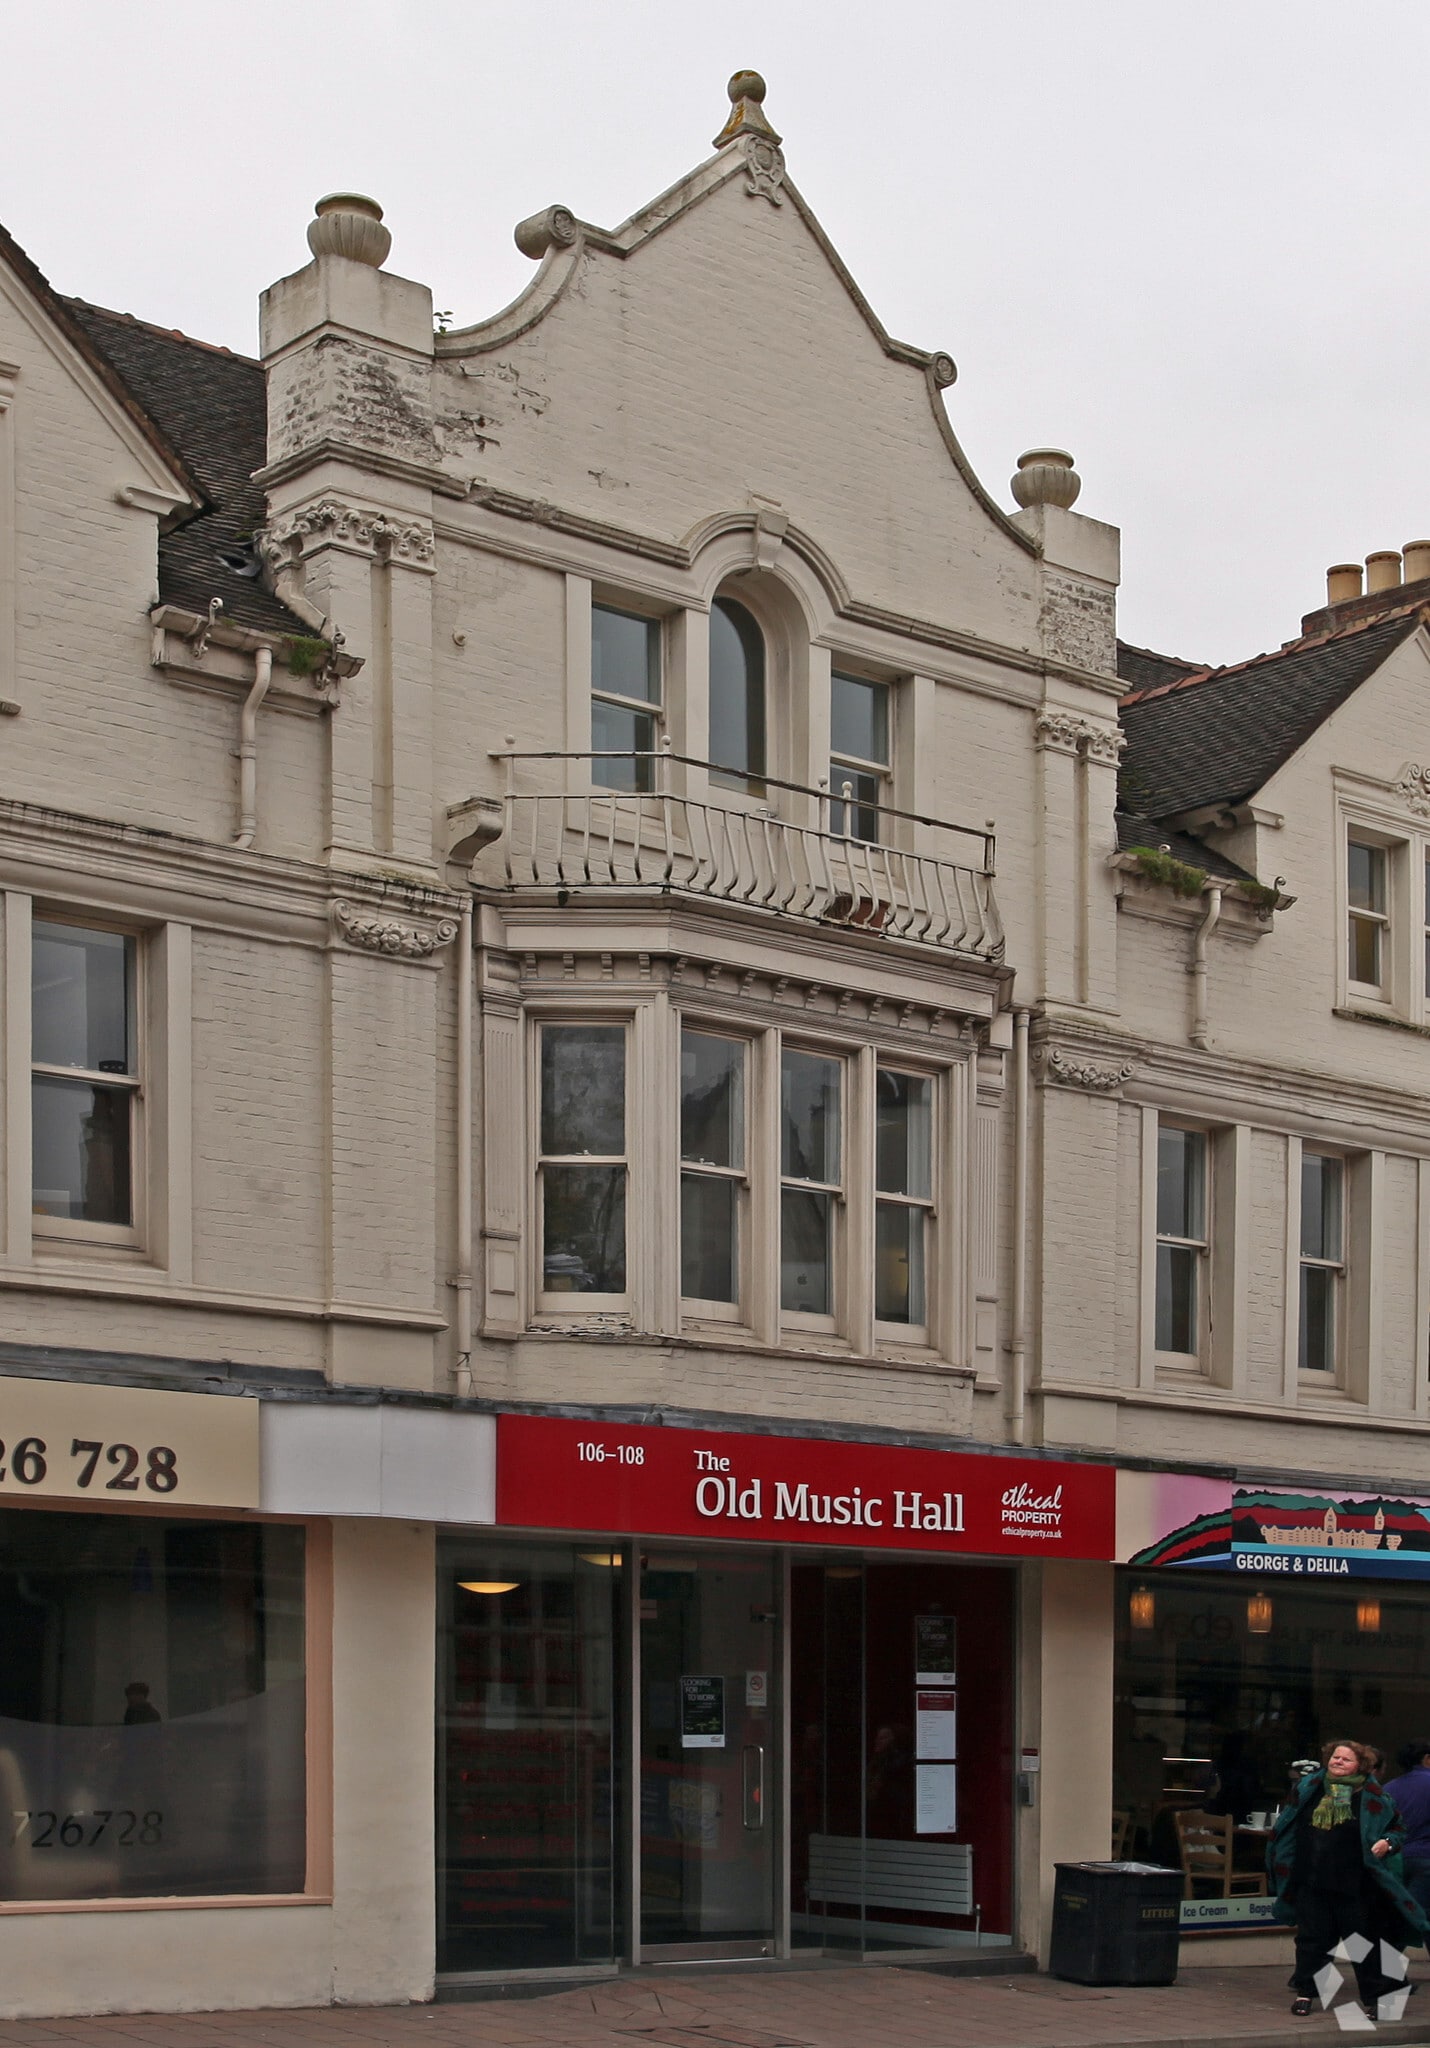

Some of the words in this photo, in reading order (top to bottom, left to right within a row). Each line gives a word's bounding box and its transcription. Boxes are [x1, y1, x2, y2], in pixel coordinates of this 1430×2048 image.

[0, 1437, 47, 1485] 6
[70, 1438, 178, 1493] 728
[693, 1450, 730, 1471] The
[696, 1476, 762, 1519] Old
[773, 1482, 883, 1527] Music
[893, 1491, 965, 1532] Hall
[1001, 1482, 1062, 1509] ethical
[1002, 1509, 1061, 1525] PROPERTY
[1236, 1554, 1289, 1571] GEORGE
[1293, 1557, 1303, 1572] &
[1307, 1557, 1349, 1574] DELILA
[9, 1809, 164, 1849] 726728
[1141, 1908, 1175, 1918] LITTER
[1183, 1906, 1197, 1917] Ice
[1199, 1904, 1228, 1916] Cream
